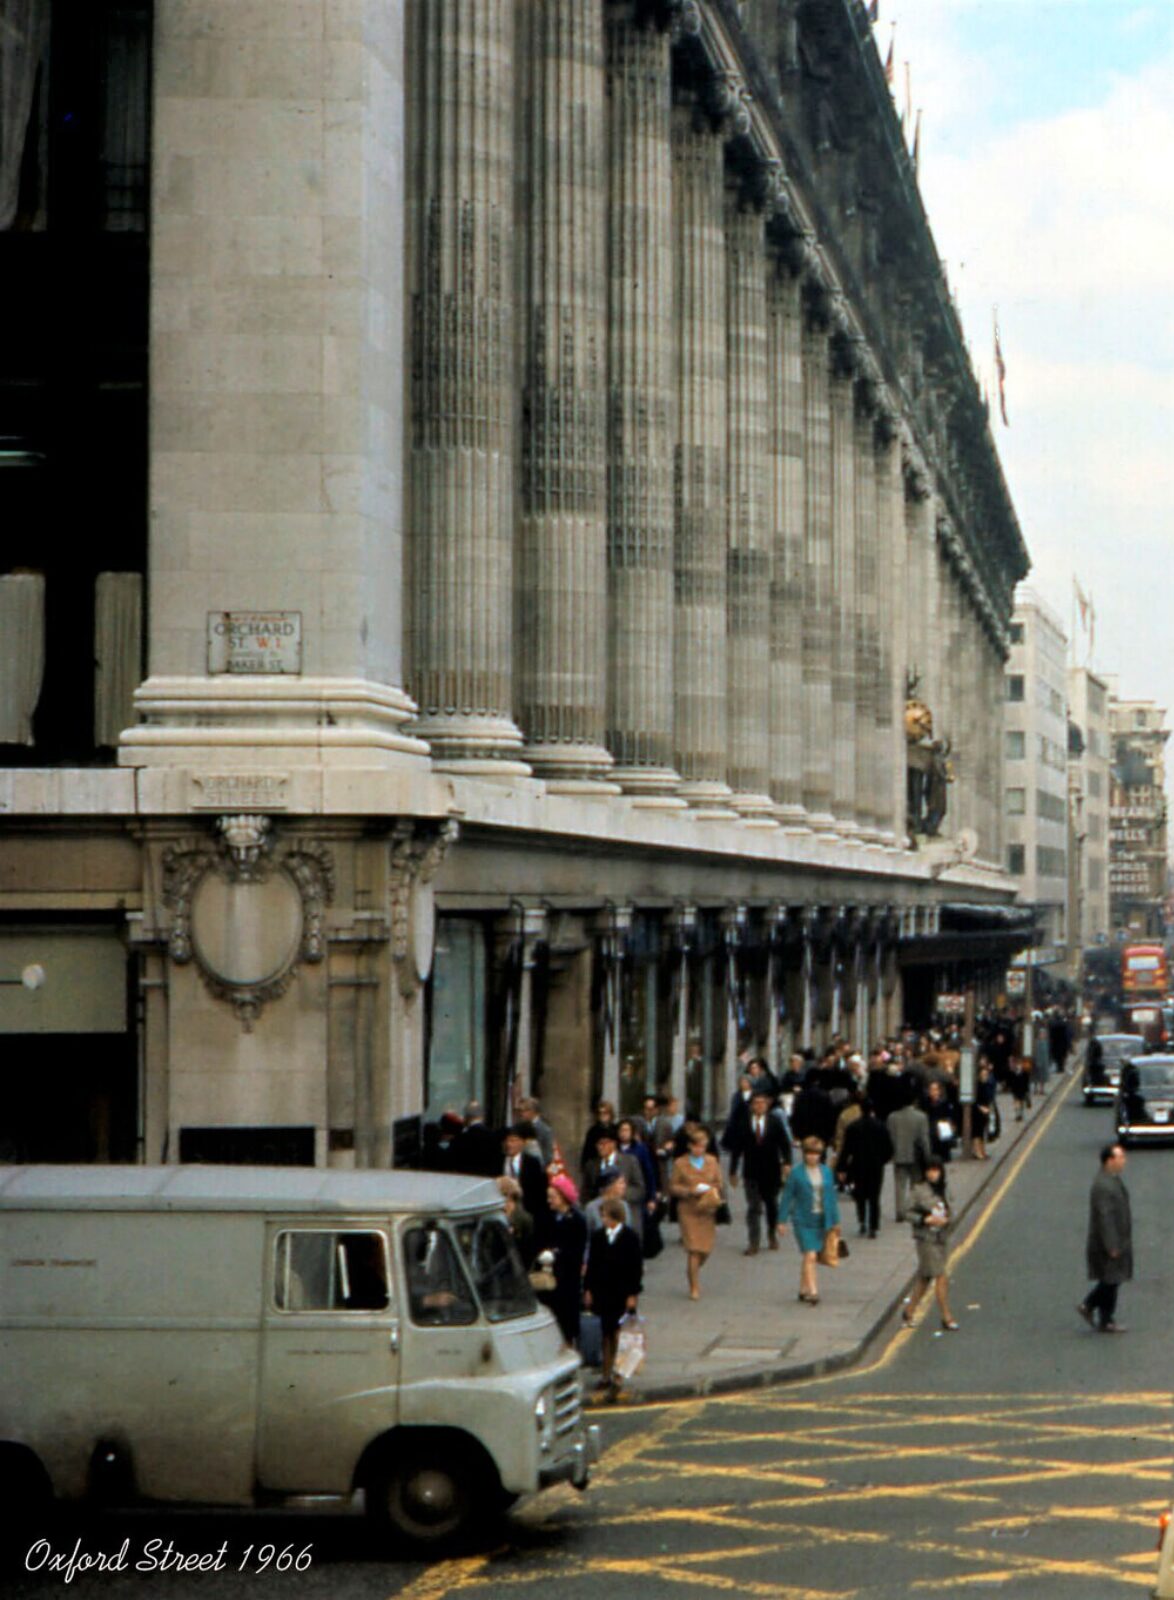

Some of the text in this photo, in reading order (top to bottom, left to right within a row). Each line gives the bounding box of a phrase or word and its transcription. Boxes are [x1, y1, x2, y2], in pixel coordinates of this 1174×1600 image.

[214, 622, 295, 636] ORCHARD
[206, 776, 275, 791] ORCHARD
[207, 792, 274, 804] STREET
